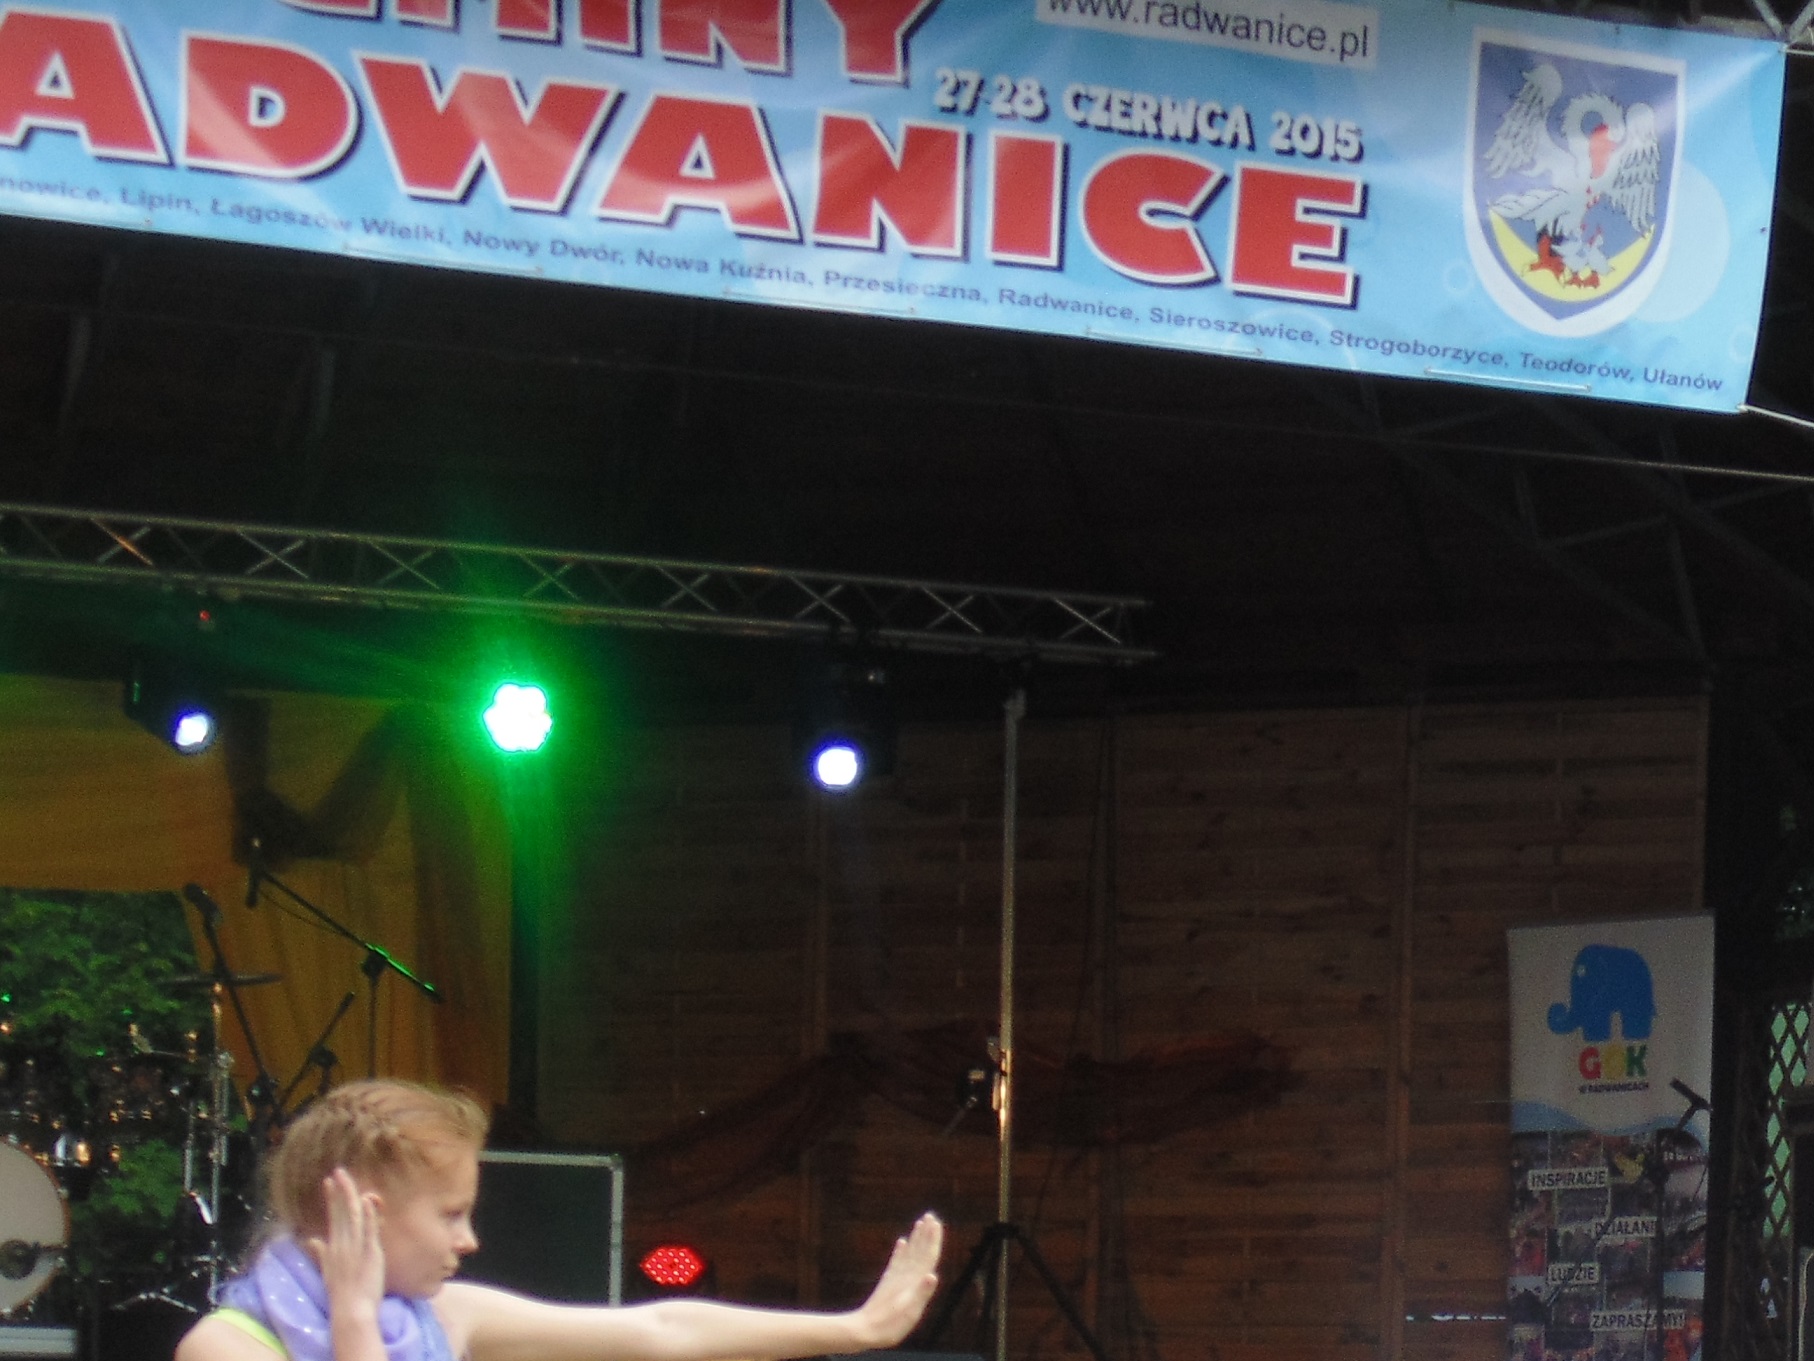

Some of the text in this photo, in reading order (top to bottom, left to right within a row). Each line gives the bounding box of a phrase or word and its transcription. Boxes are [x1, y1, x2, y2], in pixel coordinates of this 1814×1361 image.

[1062, 82, 1257, 152] CZERWCA
[1268, 110, 1365, 163] 2015
[464, 229, 542, 258] Nowy
[636, 248, 710, 274] Nowa
[999, 287, 1141, 324] Radwanice,
[1579, 1045, 1648, 1081] GOK
